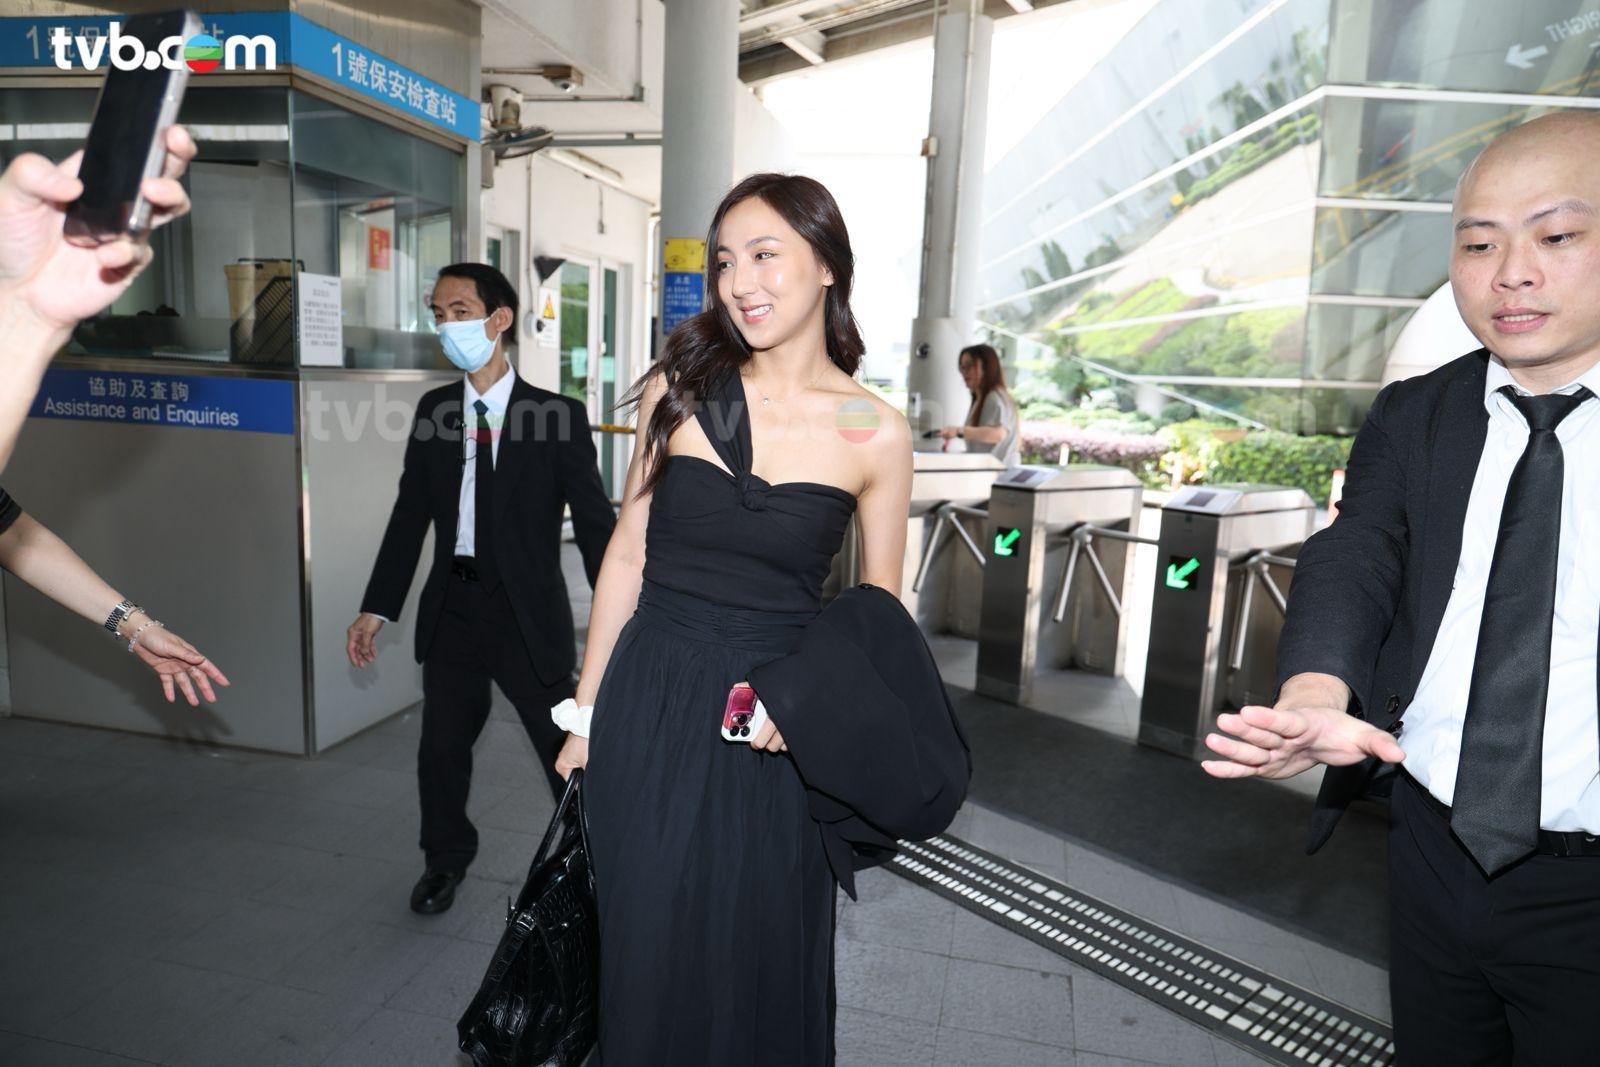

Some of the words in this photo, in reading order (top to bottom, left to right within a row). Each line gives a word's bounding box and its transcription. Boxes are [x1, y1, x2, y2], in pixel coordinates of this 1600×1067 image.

[331, 42, 457, 126] 1號保安檢查站
[88, 376, 189, 403] 協助及查詢
[44, 398, 126, 419] Assistance
[132, 404, 160, 421] and
[166, 404, 239, 427] Enquiries
